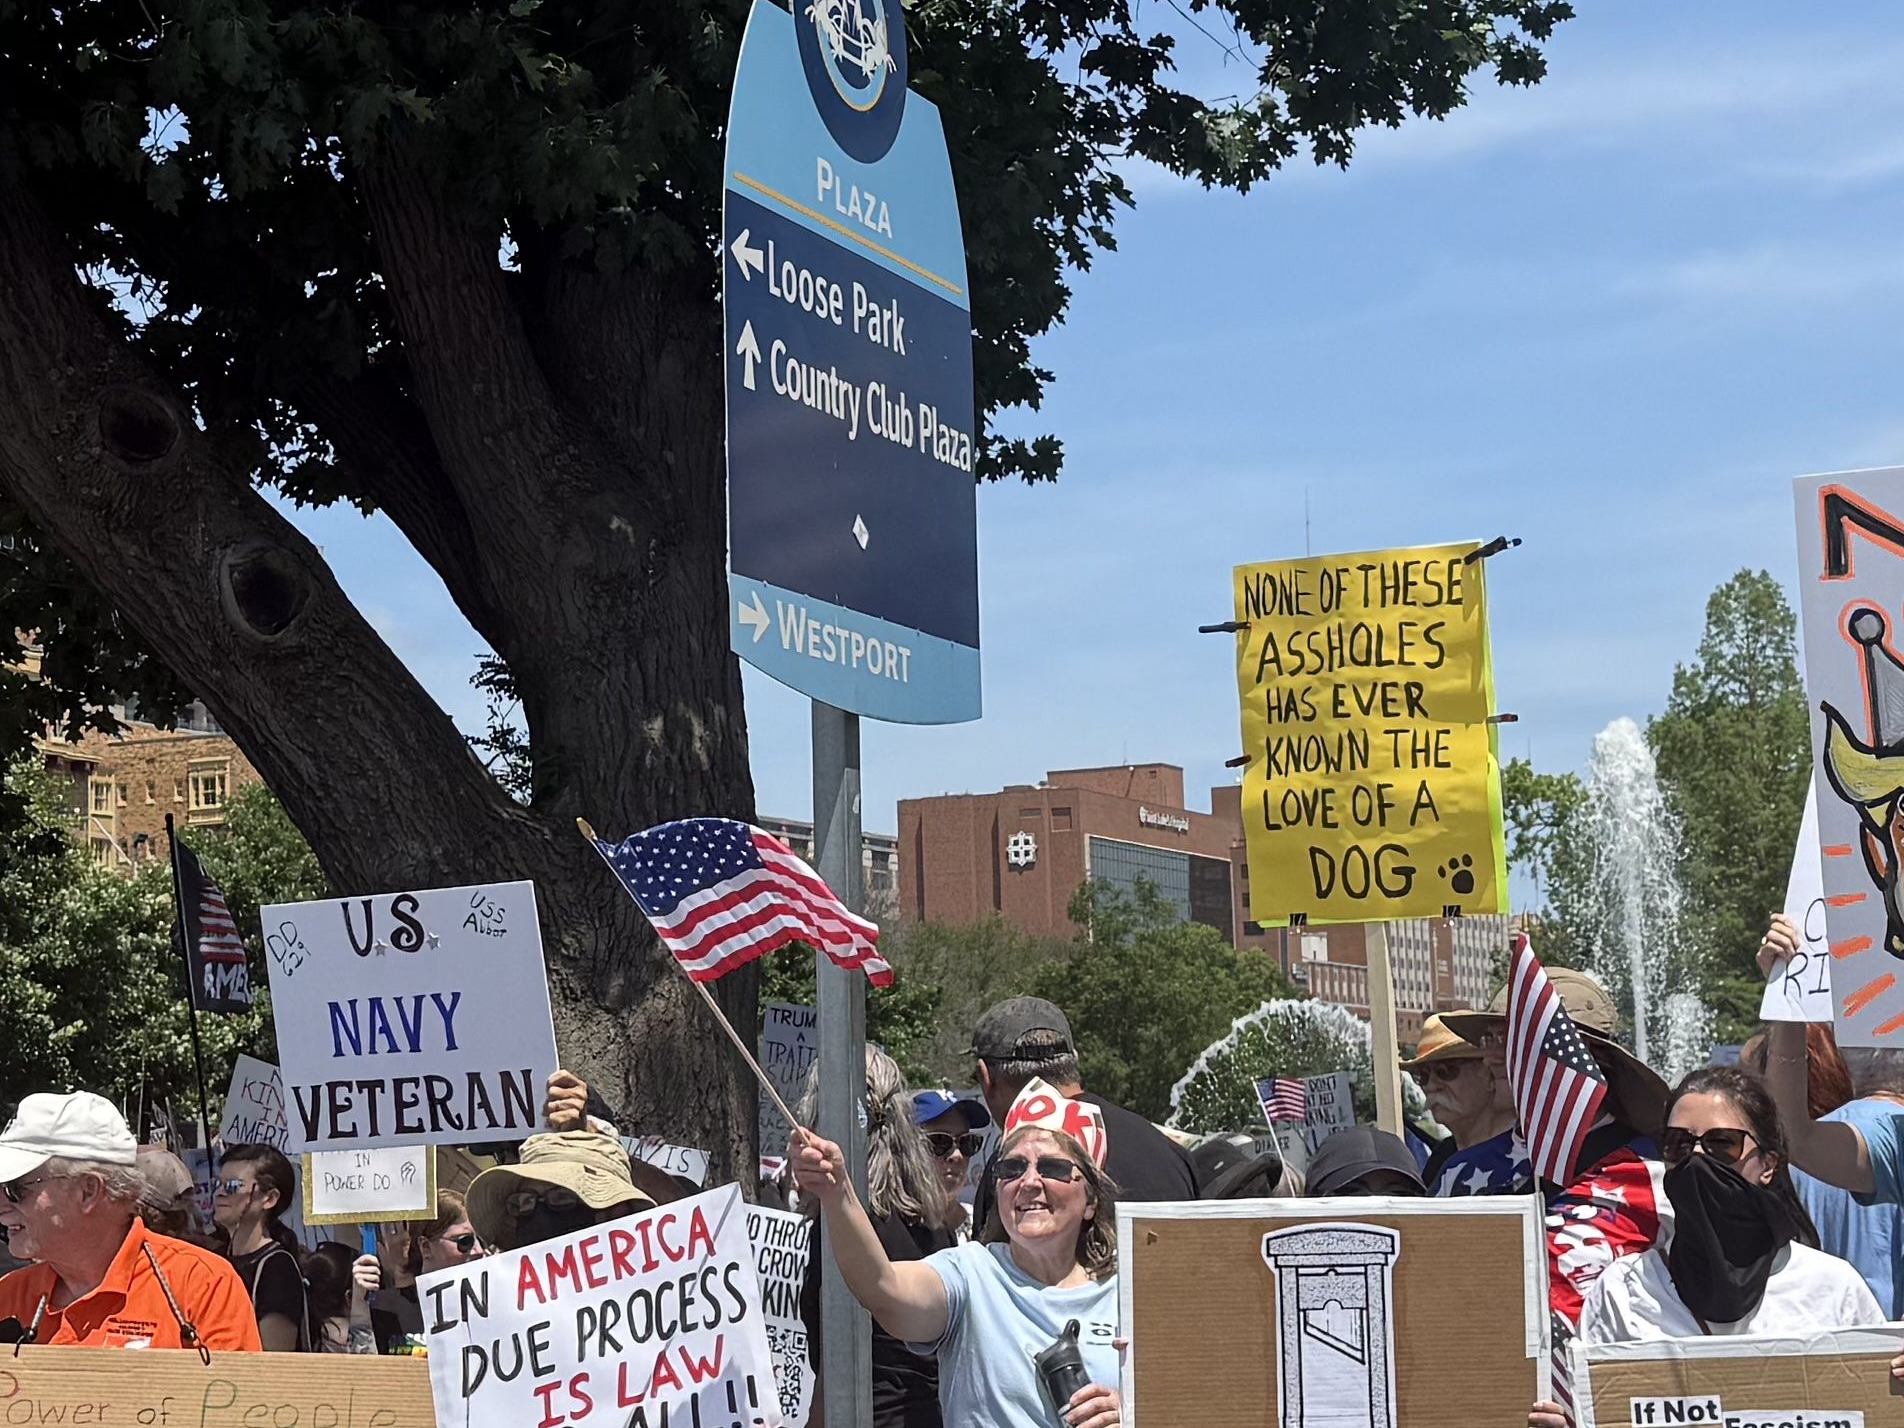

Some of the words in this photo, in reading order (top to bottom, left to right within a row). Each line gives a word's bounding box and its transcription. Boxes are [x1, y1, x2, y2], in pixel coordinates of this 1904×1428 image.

[817, 156, 893, 240] PLAZA
[767, 239, 843, 326] Loose
[853, 281, 905, 356] Park
[770, 339, 861, 440] Country
[866, 387, 913, 450] Club
[919, 403, 972, 473] Plaza
[1245, 568, 1312, 619] NONE
[1319, 567, 1351, 612] OF
[1354, 557, 1465, 609] THESE
[776, 599, 911, 685] WESTPORT
[1256, 621, 1446, 685] ASSHOLES
[1267, 686, 1317, 724] HAS
[1332, 681, 1429, 719] EVER
[1266, 727, 1370, 780] KNOWN
[1383, 728, 1452, 769] THE
[1264, 787, 1339, 831] LOVE
[1352, 783, 1396, 827] OF
[1409, 779, 1440, 827] A
[1309, 843, 1417, 900] DOG
[470, 891, 506, 924] USS
[328, 991, 463, 1058] NAVY
[292, 1068, 537, 1143] VETERAN
[324, 1172, 364, 1191] POWER
[373, 1172, 390, 1189] DO
[355, 1153, 371, 1167] IN
[426, 1271, 489, 1335] IN
[517, 1205, 716, 1311] AMERICA
[462, 1321, 556, 1398] DUE
[577, 1262, 747, 1362] PROCESS
[617, 1334, 724, 1408] LAW
[136, 1395, 172, 1426] of
[1634, 1402, 1656, 1425] If
[1664, 1400, 1719, 1423] Not
